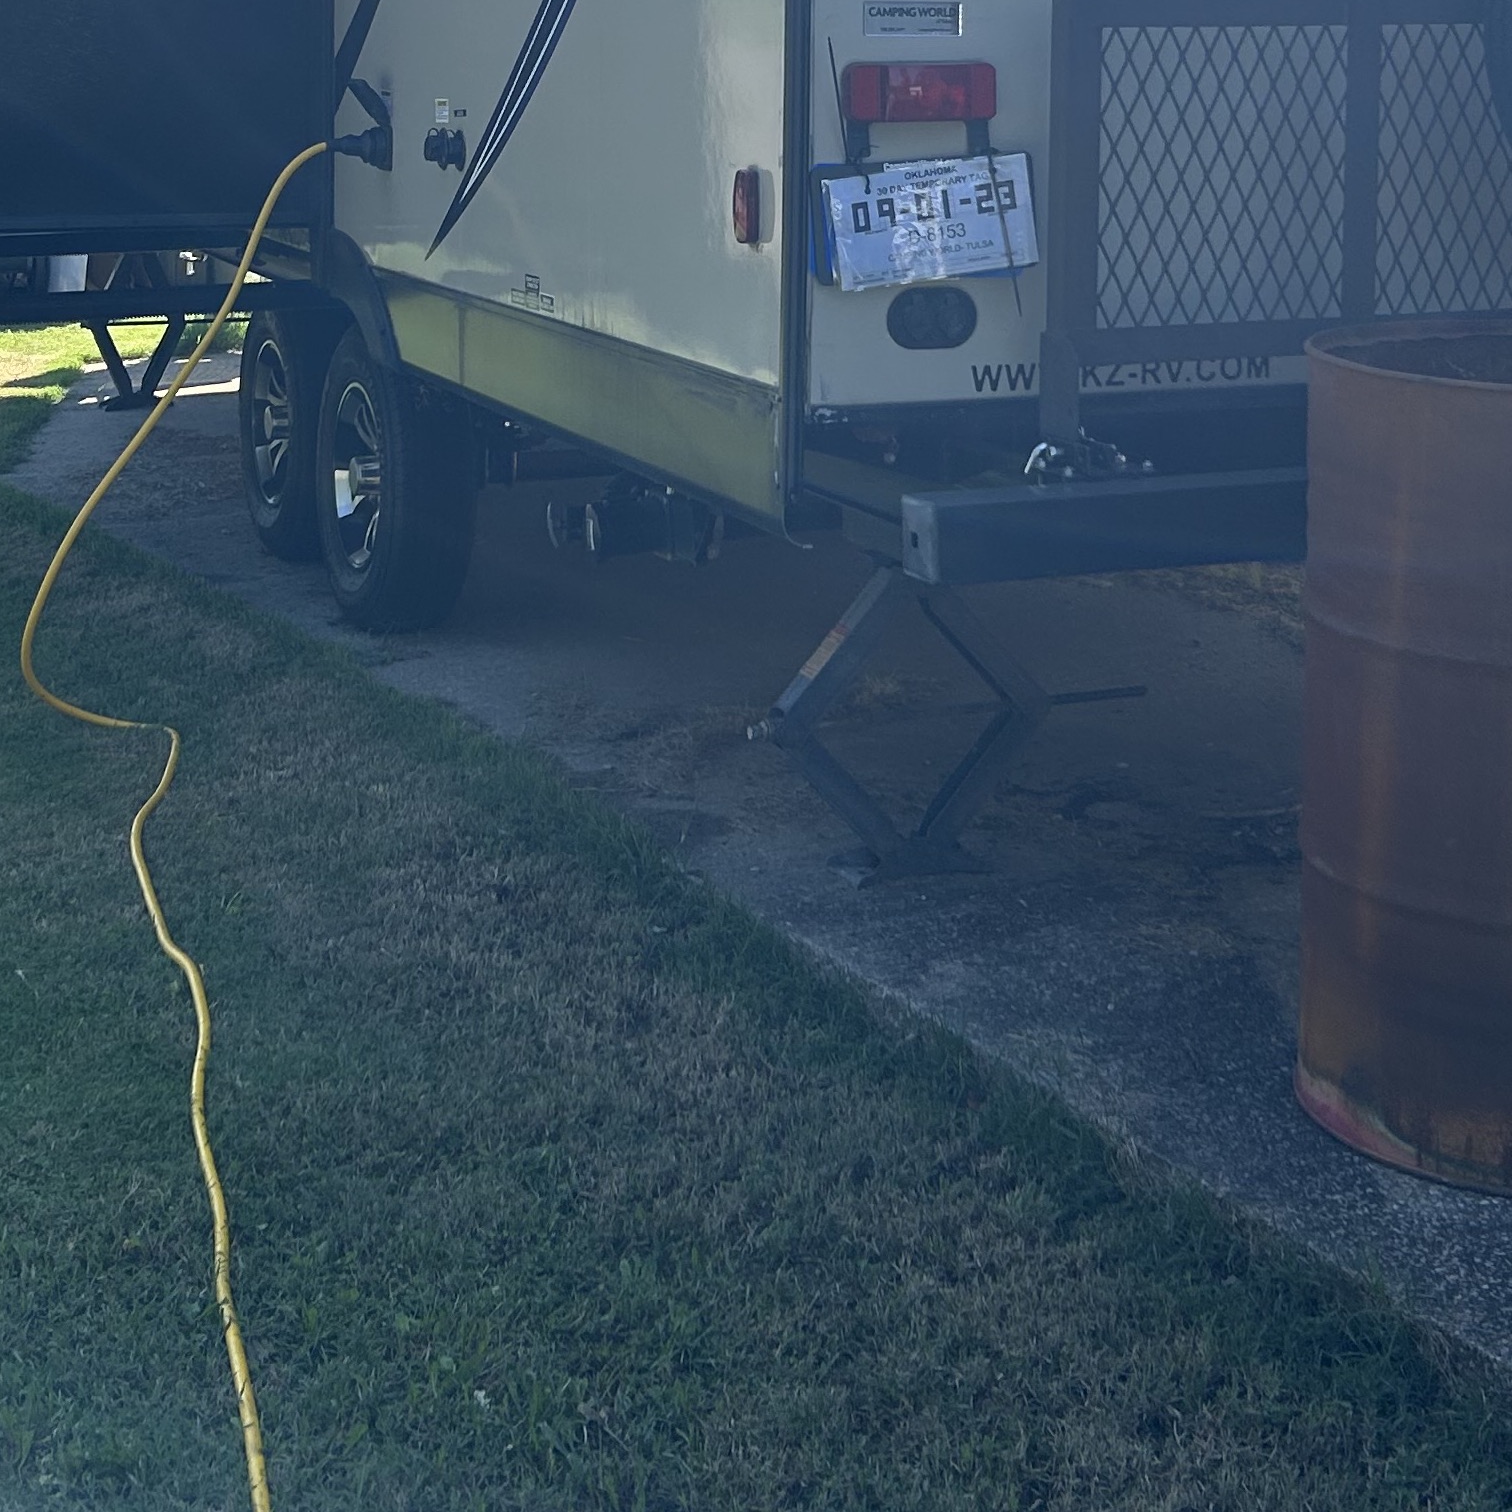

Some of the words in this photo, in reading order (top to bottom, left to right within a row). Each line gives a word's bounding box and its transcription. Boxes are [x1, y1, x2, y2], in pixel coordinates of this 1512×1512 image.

[868, 6, 916, 19] CAMPING
[917, 6, 957, 19] WORLD
[904, 165, 958, 180] OKLAHOMA
[876, 186, 889, 196] 30
[969, 172, 990, 183] TAG
[851, 179, 1018, 234] 09-01-23
[965, 239, 994, 251] TULSA
[972, 355, 1271, 393] WWKZ-RV.COM
